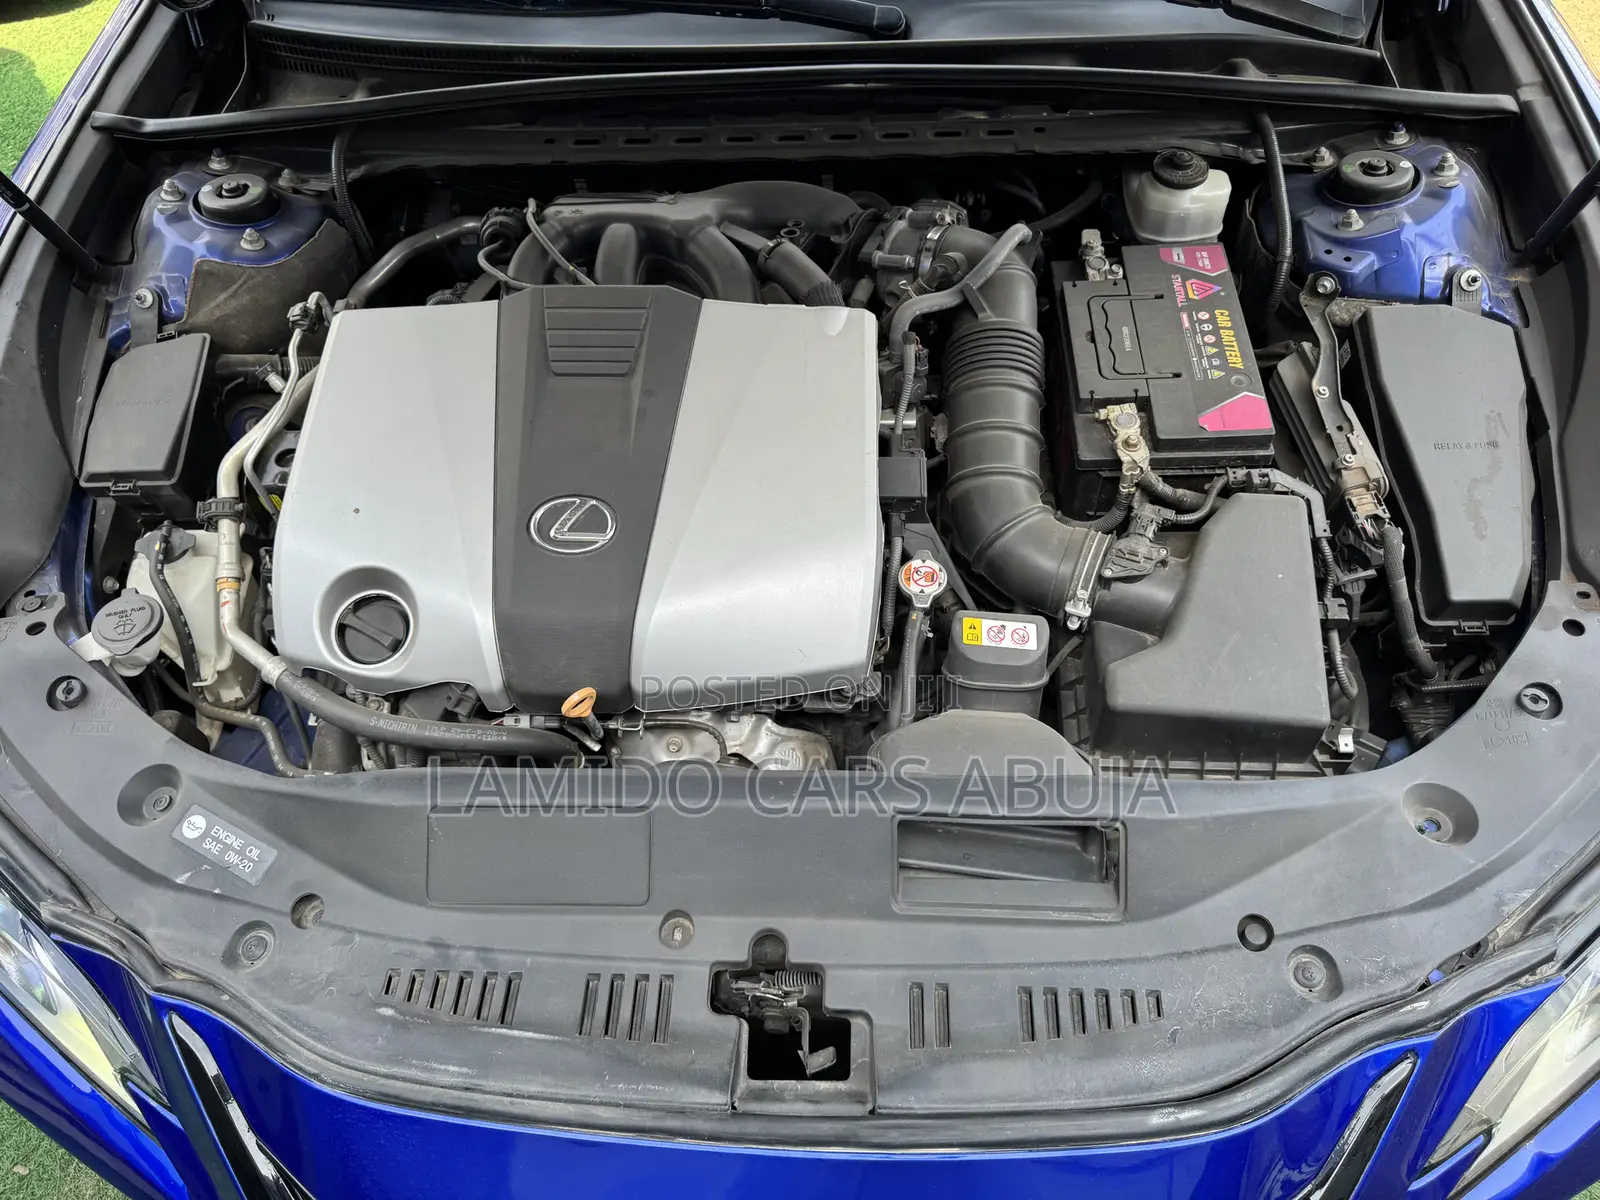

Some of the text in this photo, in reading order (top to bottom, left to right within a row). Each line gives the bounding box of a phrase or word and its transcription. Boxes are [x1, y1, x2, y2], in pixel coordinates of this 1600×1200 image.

[1214, 309, 1244, 369] CAR BATTERY
[1433, 441, 1463, 450] RELAY
[202, 838, 253, 873] SAE 0W-20
[210, 825, 261, 861] ENGINE OIL
